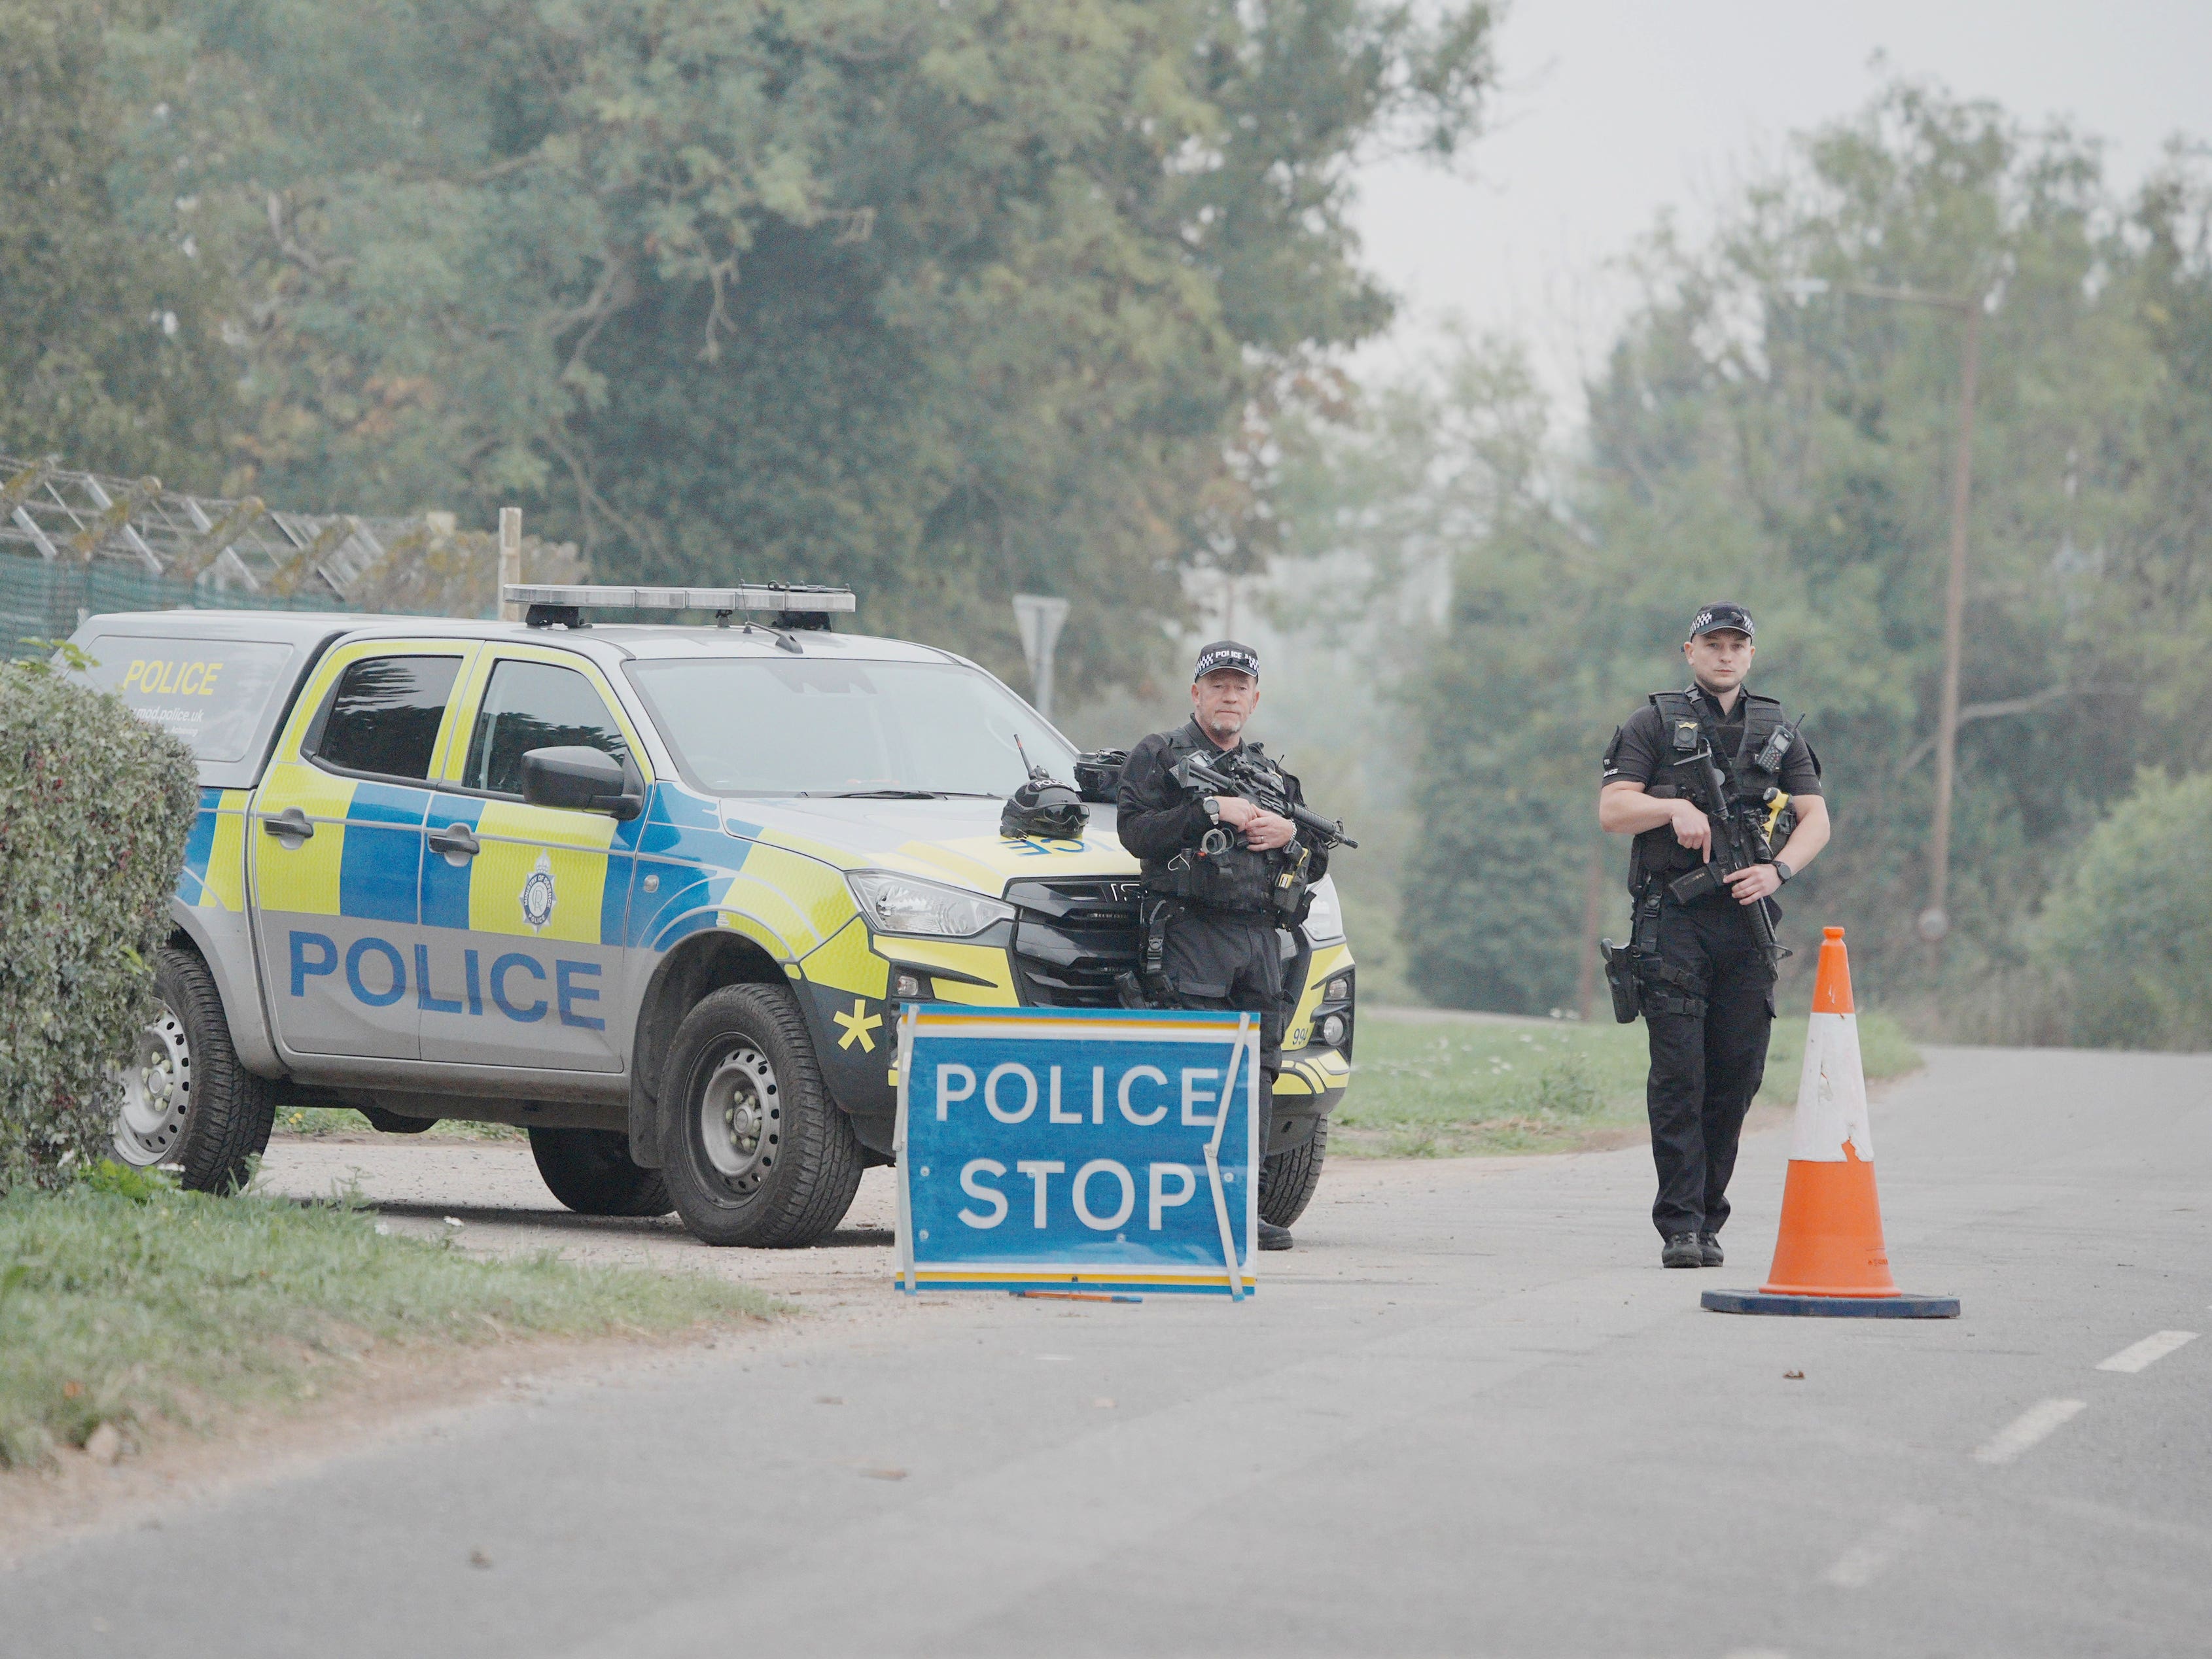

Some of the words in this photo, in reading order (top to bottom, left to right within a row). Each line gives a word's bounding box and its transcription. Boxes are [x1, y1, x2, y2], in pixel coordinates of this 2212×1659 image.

[1215, 650, 1242, 659] POLICE
[123, 659, 223, 695] POLICE
[525, 876, 536, 905] MINISTRY
[529, 914, 545, 923] POLICE
[289, 930, 605, 1030] POLICE
[936, 1062, 1219, 1126] POLICE
[957, 1158, 1197, 1231] STOP
